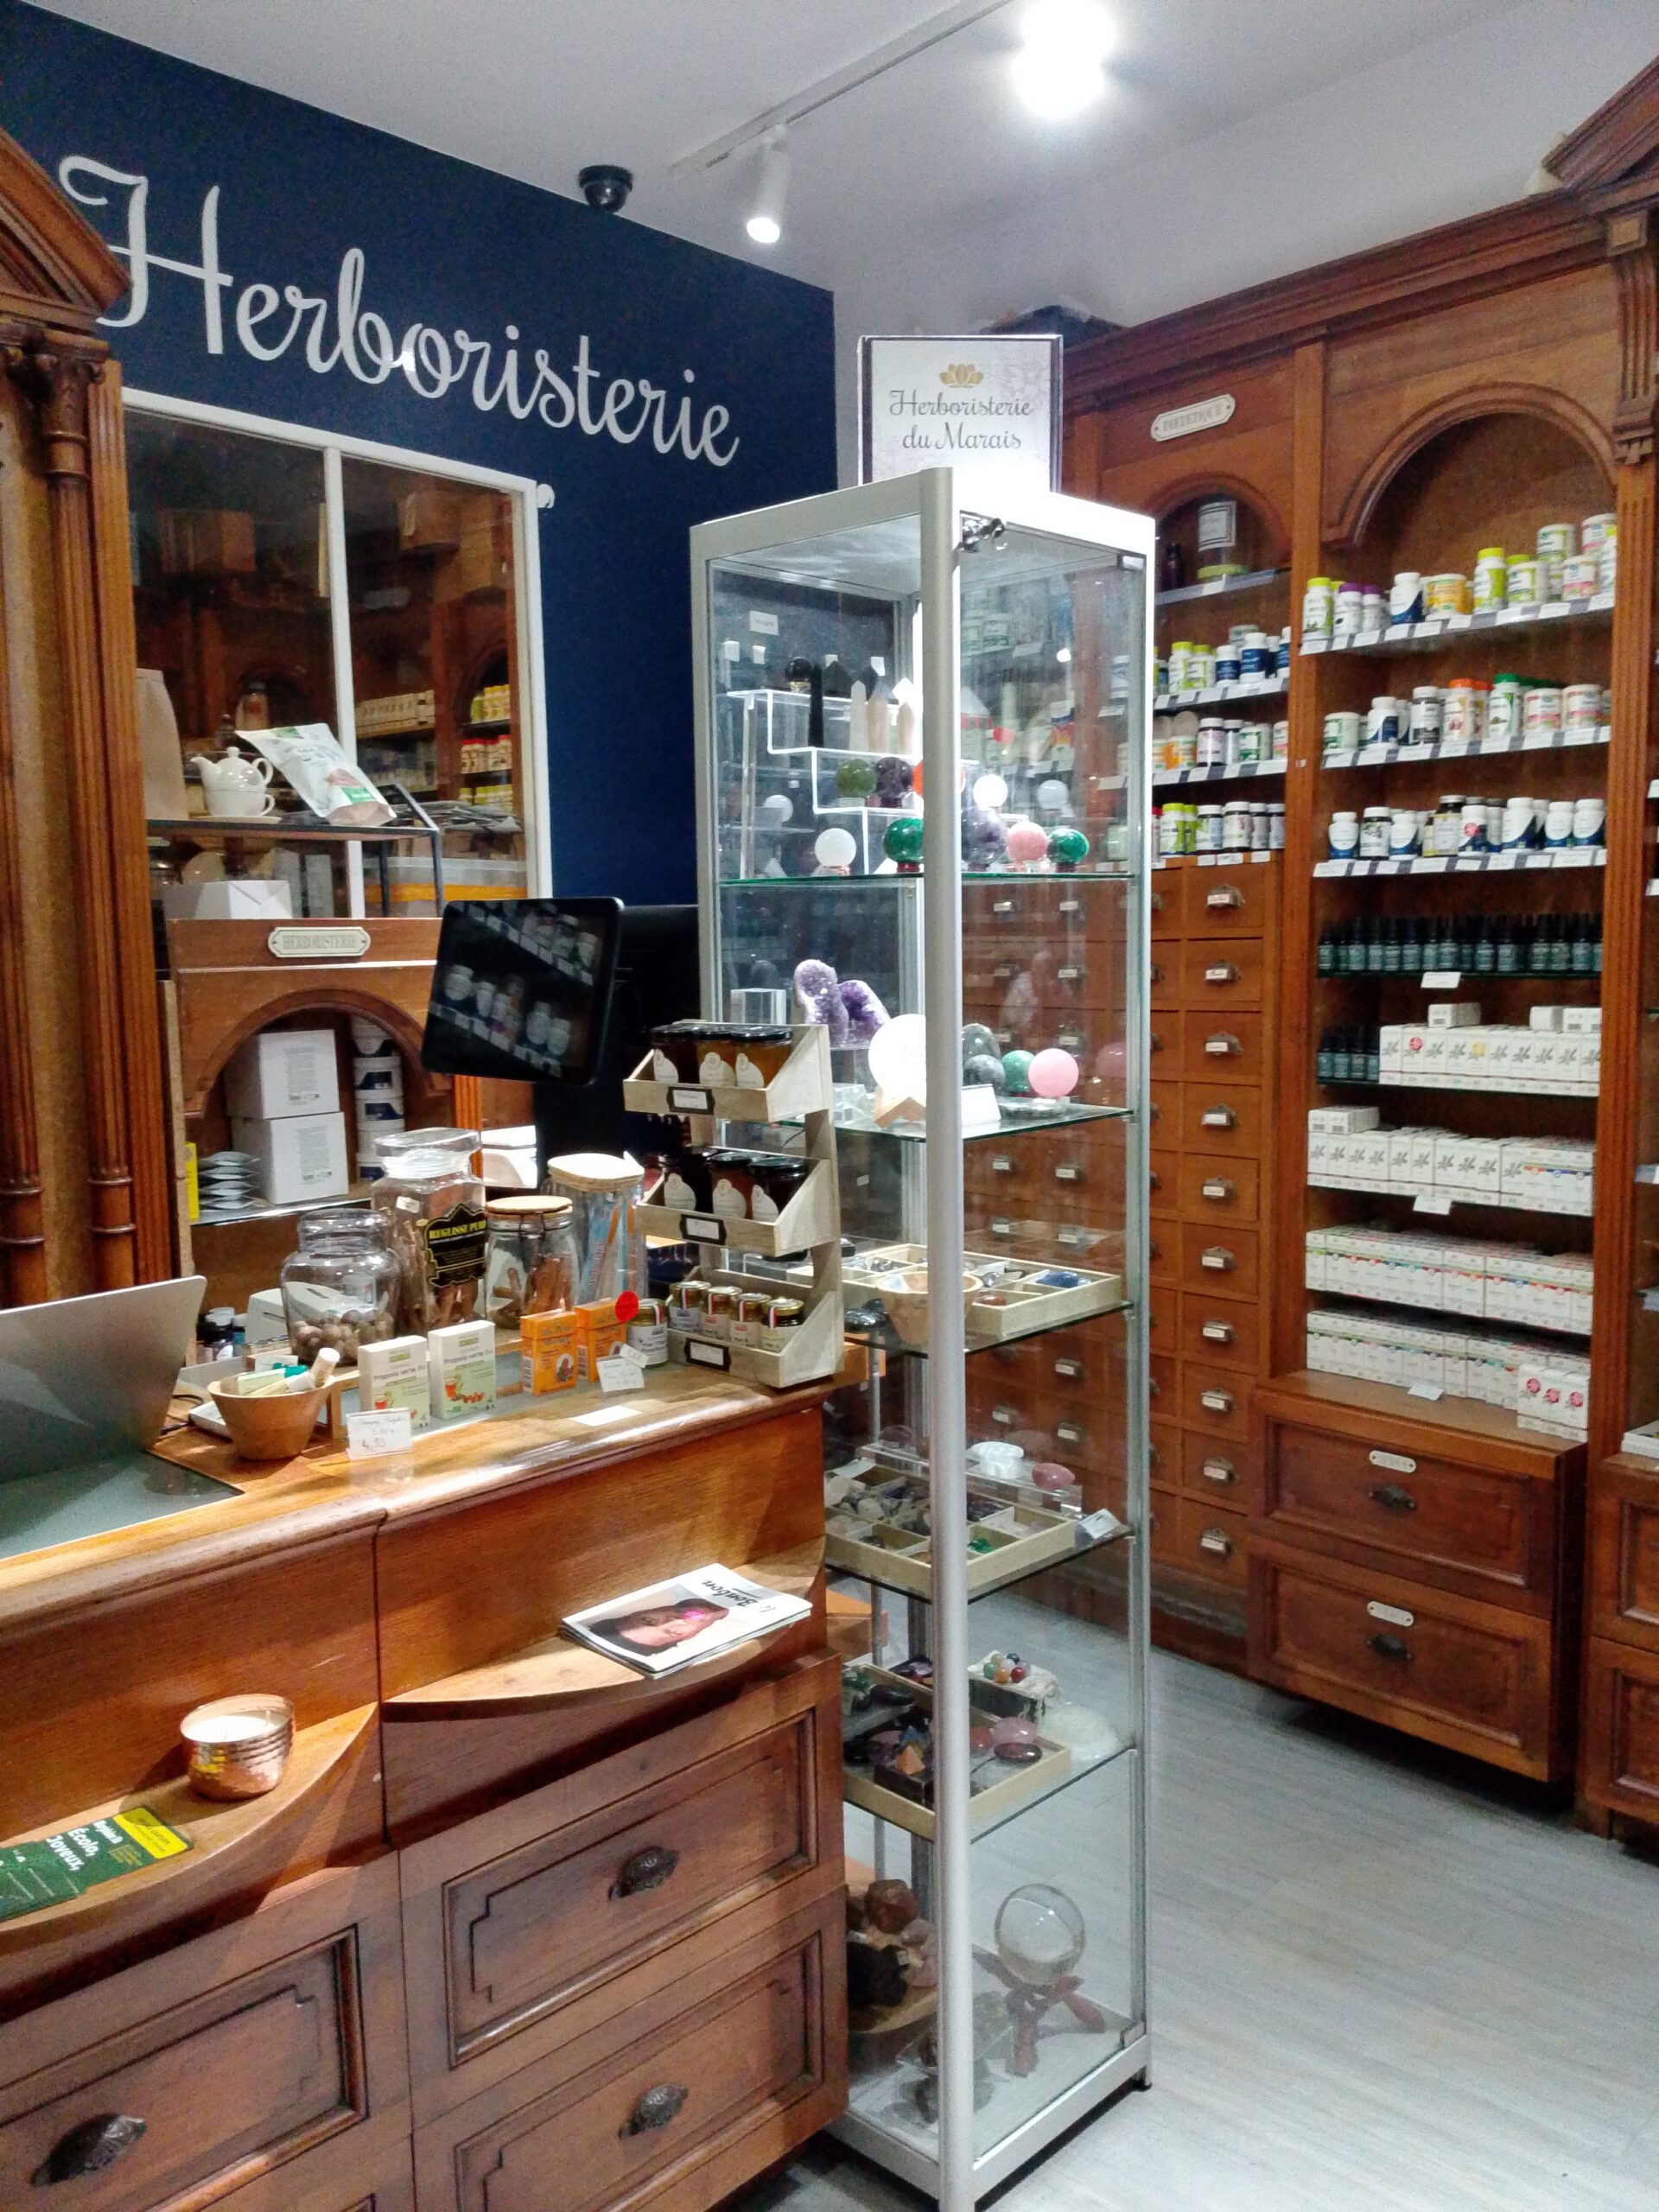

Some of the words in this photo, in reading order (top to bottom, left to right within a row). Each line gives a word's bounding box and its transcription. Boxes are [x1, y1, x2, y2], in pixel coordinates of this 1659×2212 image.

[58, 154, 741, 469] Herboristerie
[889, 389, 1033, 416] Herboristerie
[902, 423, 931, 449] du
[934, 421, 1022, 450] Marais
[701, 1579, 760, 1607] Bonbon
[46, 1834, 85, 1872] Joyeux,
[67, 1827, 99, 1857] Écolo,
